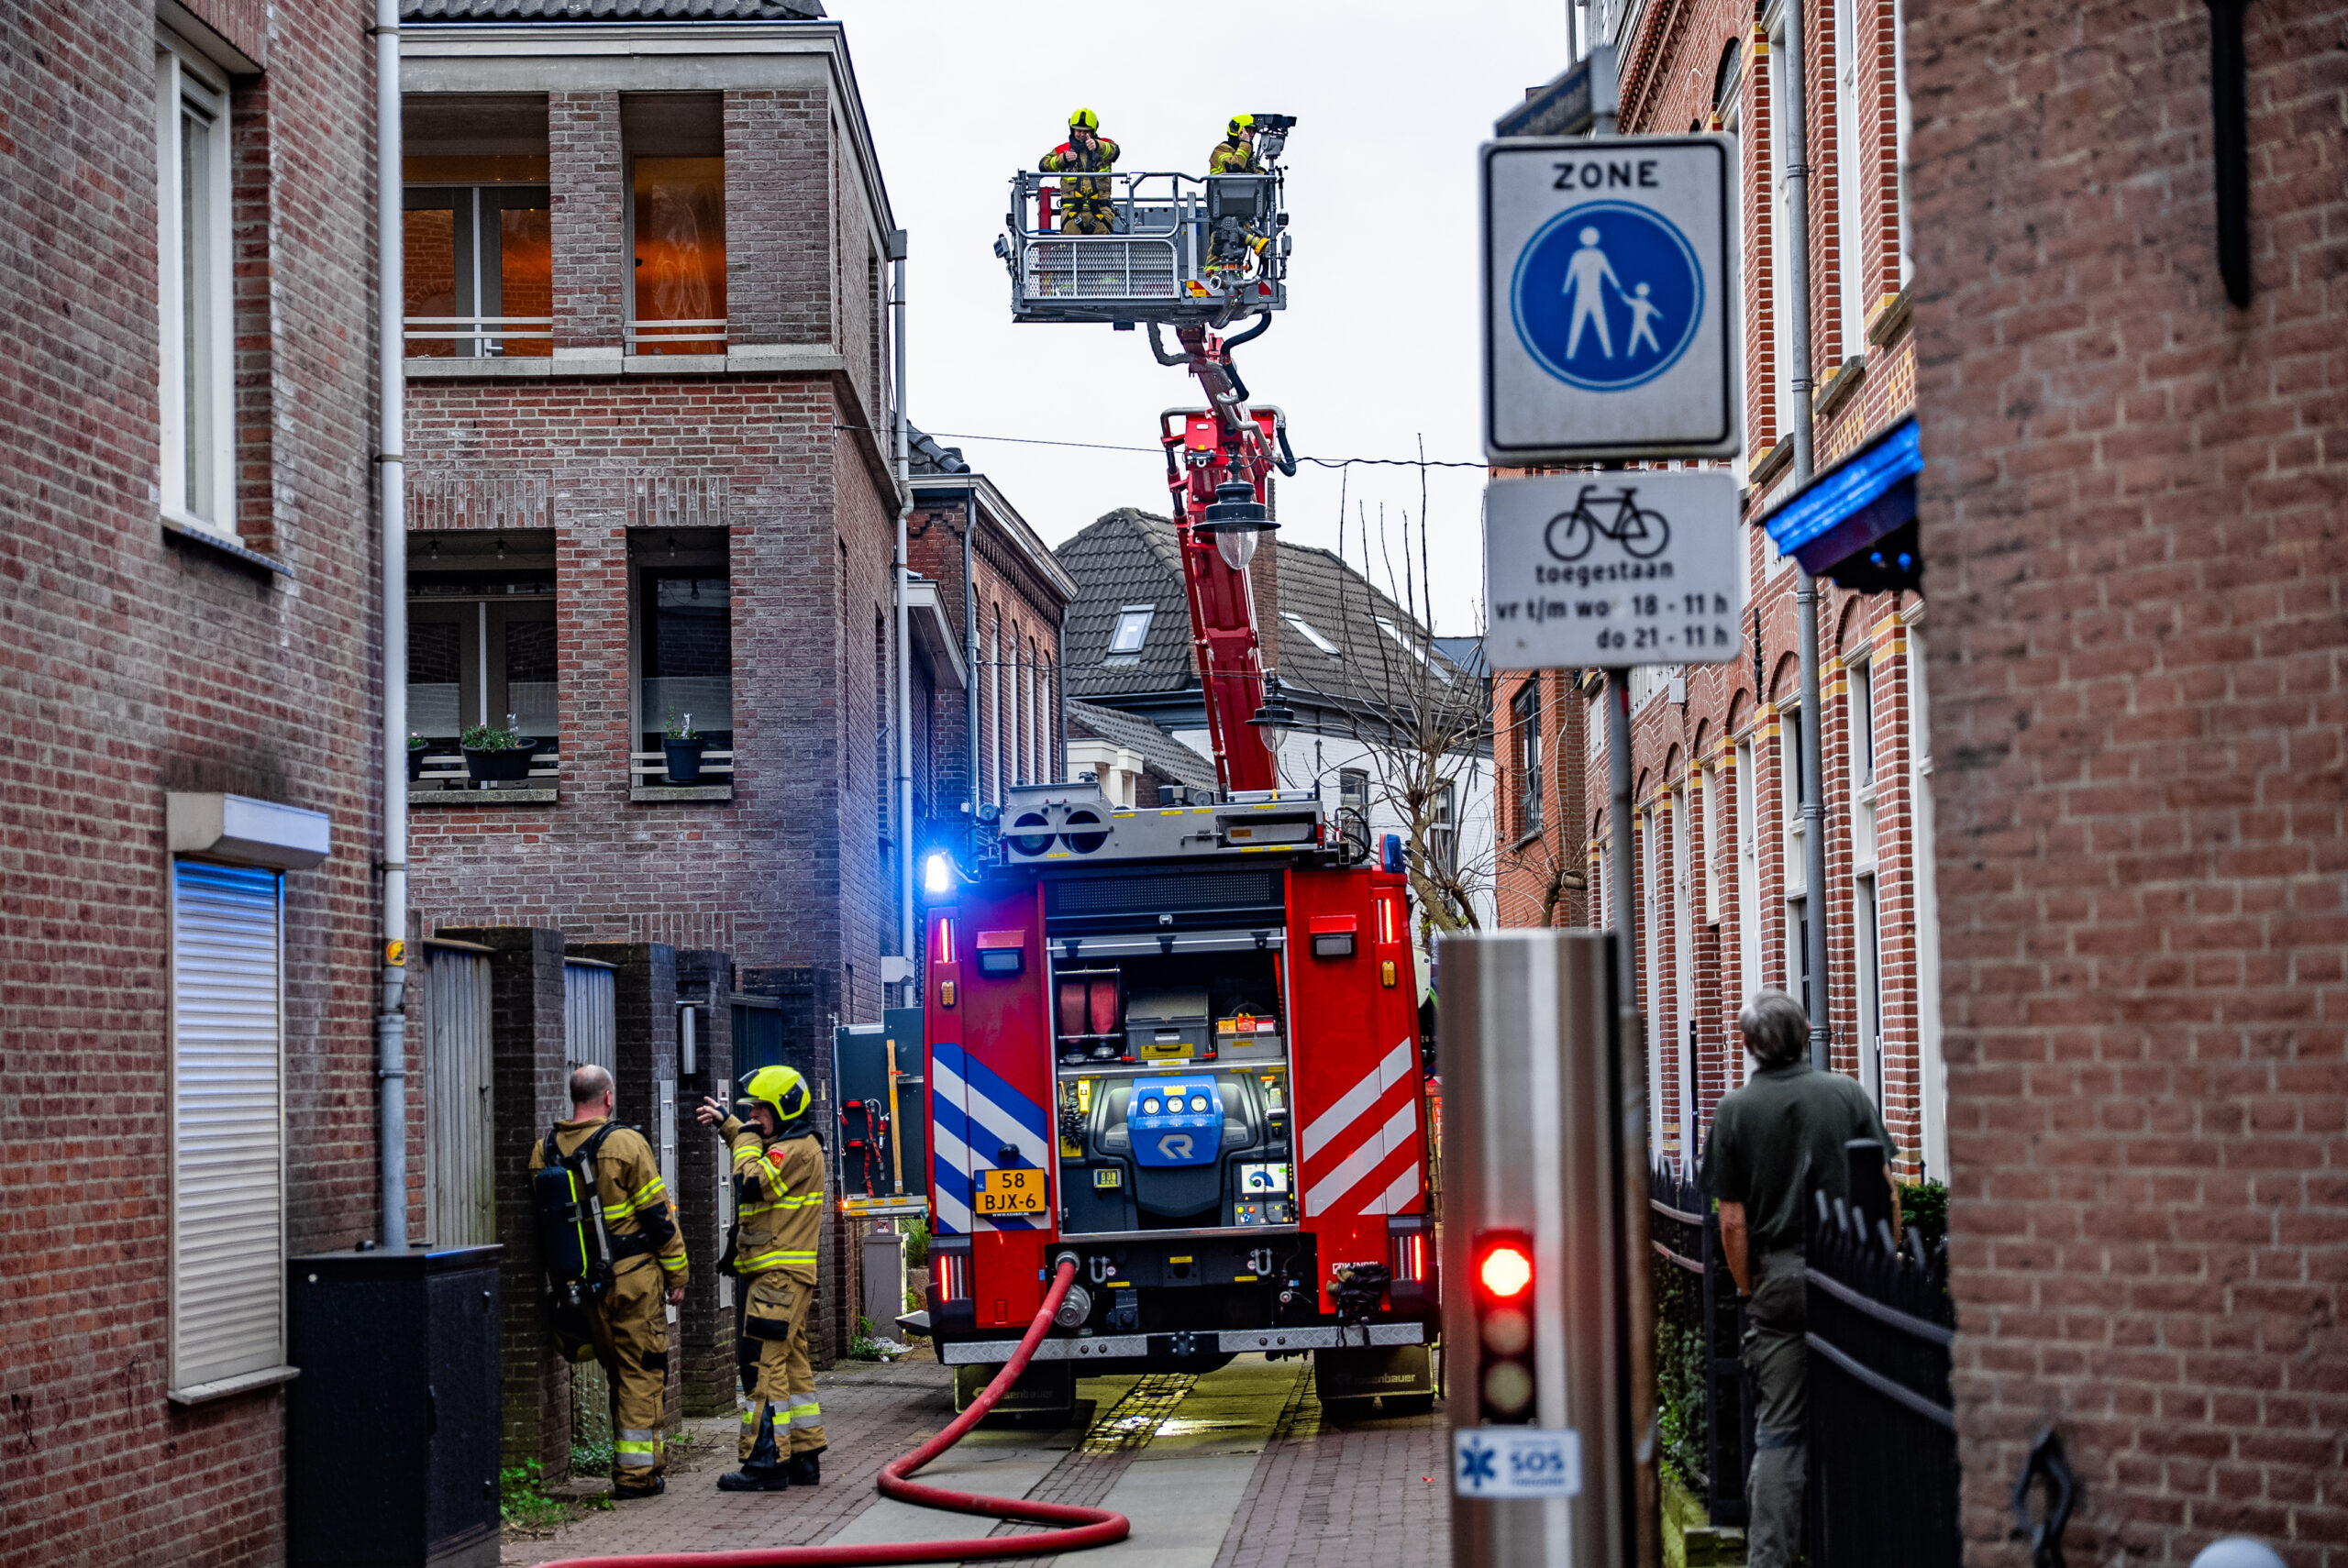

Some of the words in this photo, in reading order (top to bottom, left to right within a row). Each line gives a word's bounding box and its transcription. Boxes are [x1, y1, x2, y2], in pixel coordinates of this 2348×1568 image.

[1553, 160, 1660, 191] ZONE
[1535, 561, 1674, 588] toegestaan
[1495, 602, 1519, 620] vr
[1526, 598, 1567, 624] t/m
[1575, 601, 1611, 619] wo
[1633, 594, 1659, 615] 18
[1684, 593, 1705, 615] 11
[1713, 593, 1728, 614] h
[1596, 628, 1626, 650] do
[1634, 627, 1659, 648] 21
[1683, 625, 1706, 646] 11
[1713, 625, 1728, 646] h
[1002, 1173, 1024, 1188] 58
[985, 1193, 1036, 1210] BJX-6
[1511, 1451, 1564, 1471] SOS
